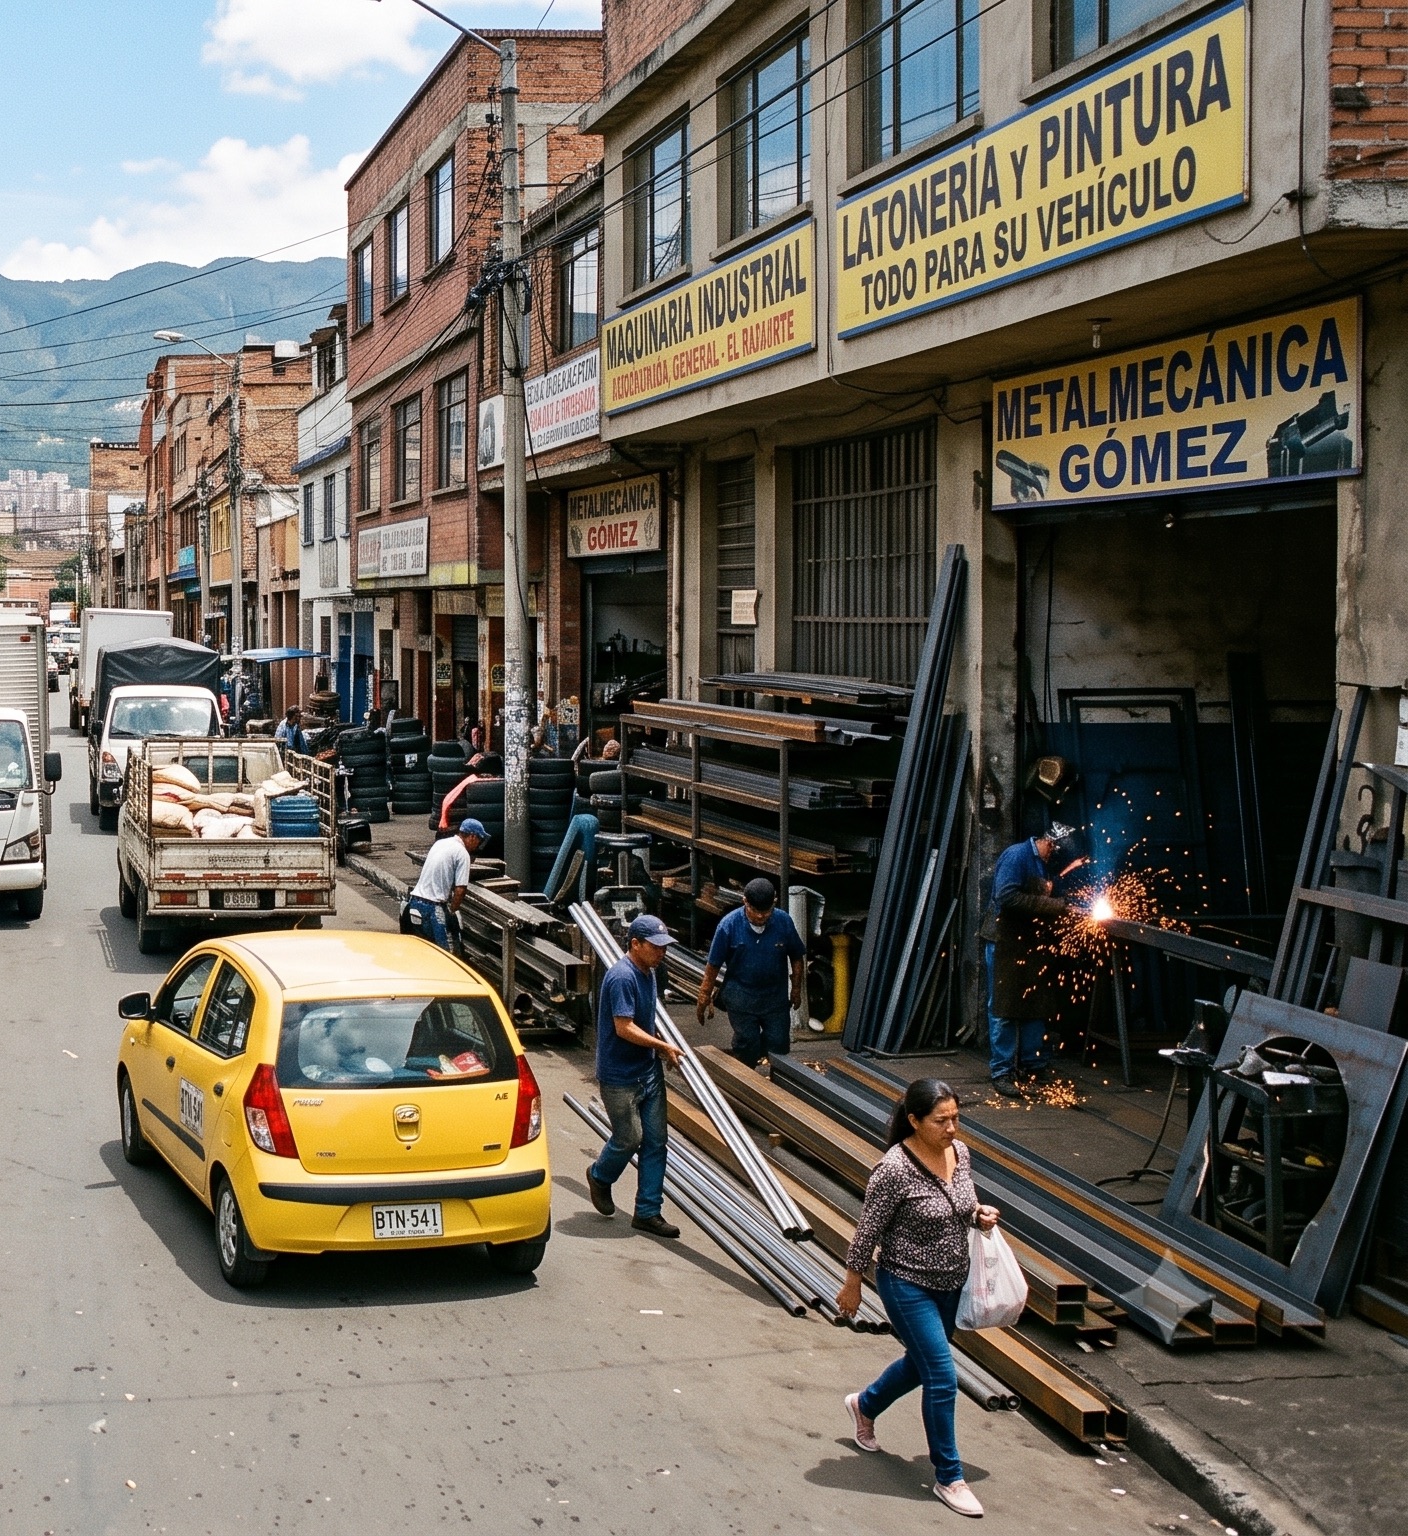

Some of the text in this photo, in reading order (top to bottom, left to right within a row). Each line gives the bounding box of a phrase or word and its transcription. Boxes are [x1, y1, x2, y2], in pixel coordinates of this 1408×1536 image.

[843, 138, 1002, 271] LATONERÍA
[1040, 34, 1231, 189] PINTURA
[861, 146, 1196, 315] TODO PARA SU VEHÍCULO
[606, 239, 806, 371] MAQUINARIA INDUSTRIAL
[673, 341, 720, 381] GENERAL
[727, 332, 739, 362] EL
[997, 317, 1348, 442] METALMECÁNICA
[570, 481, 657, 520] METALMECÁNICA
[1059, 418, 1247, 494] GÓMEZ
[587, 520, 638, 551] GÓMEZ
